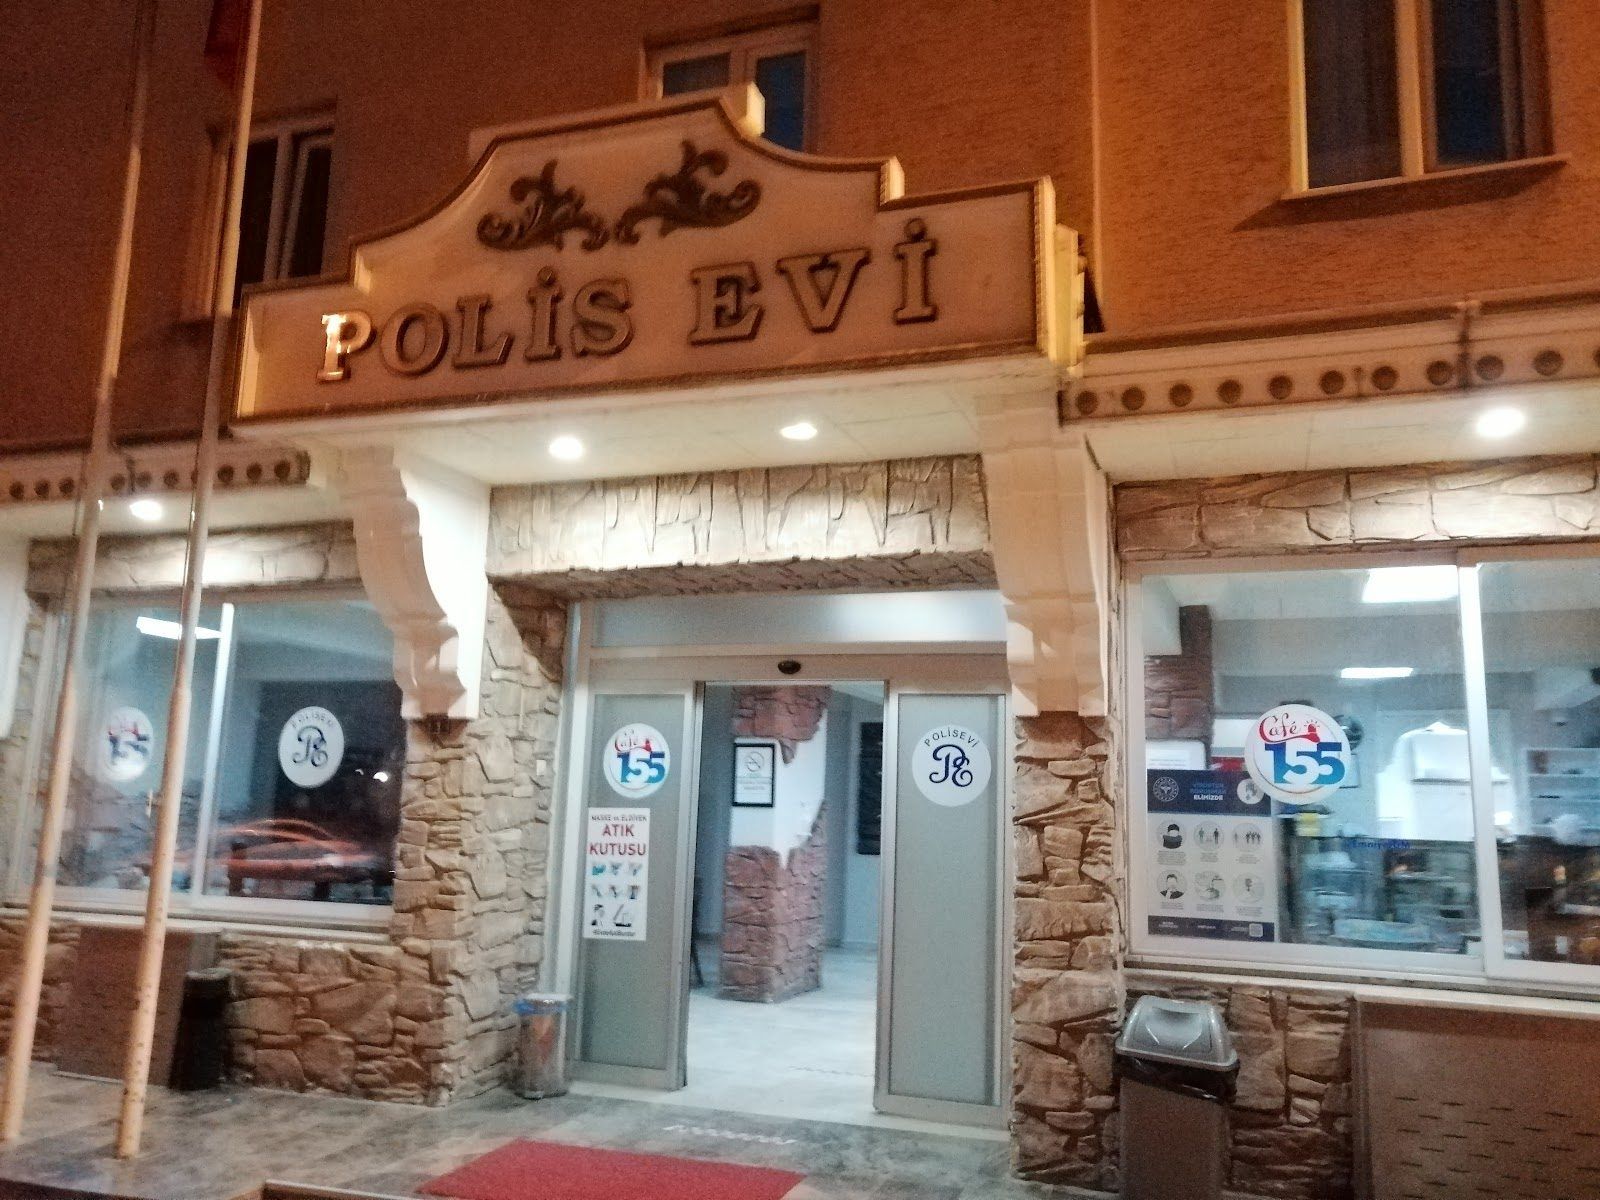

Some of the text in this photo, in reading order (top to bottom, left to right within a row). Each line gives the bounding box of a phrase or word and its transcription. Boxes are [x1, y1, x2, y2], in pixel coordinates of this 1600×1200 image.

[317, 217, 938, 385] POLİS EVİ
[1259, 712, 1308, 743] Café
[616, 751, 666, 784] 155
[1264, 741, 1346, 785] 155
[602, 823, 635, 837] ATIK
[589, 842, 647, 856] KUTUSU
